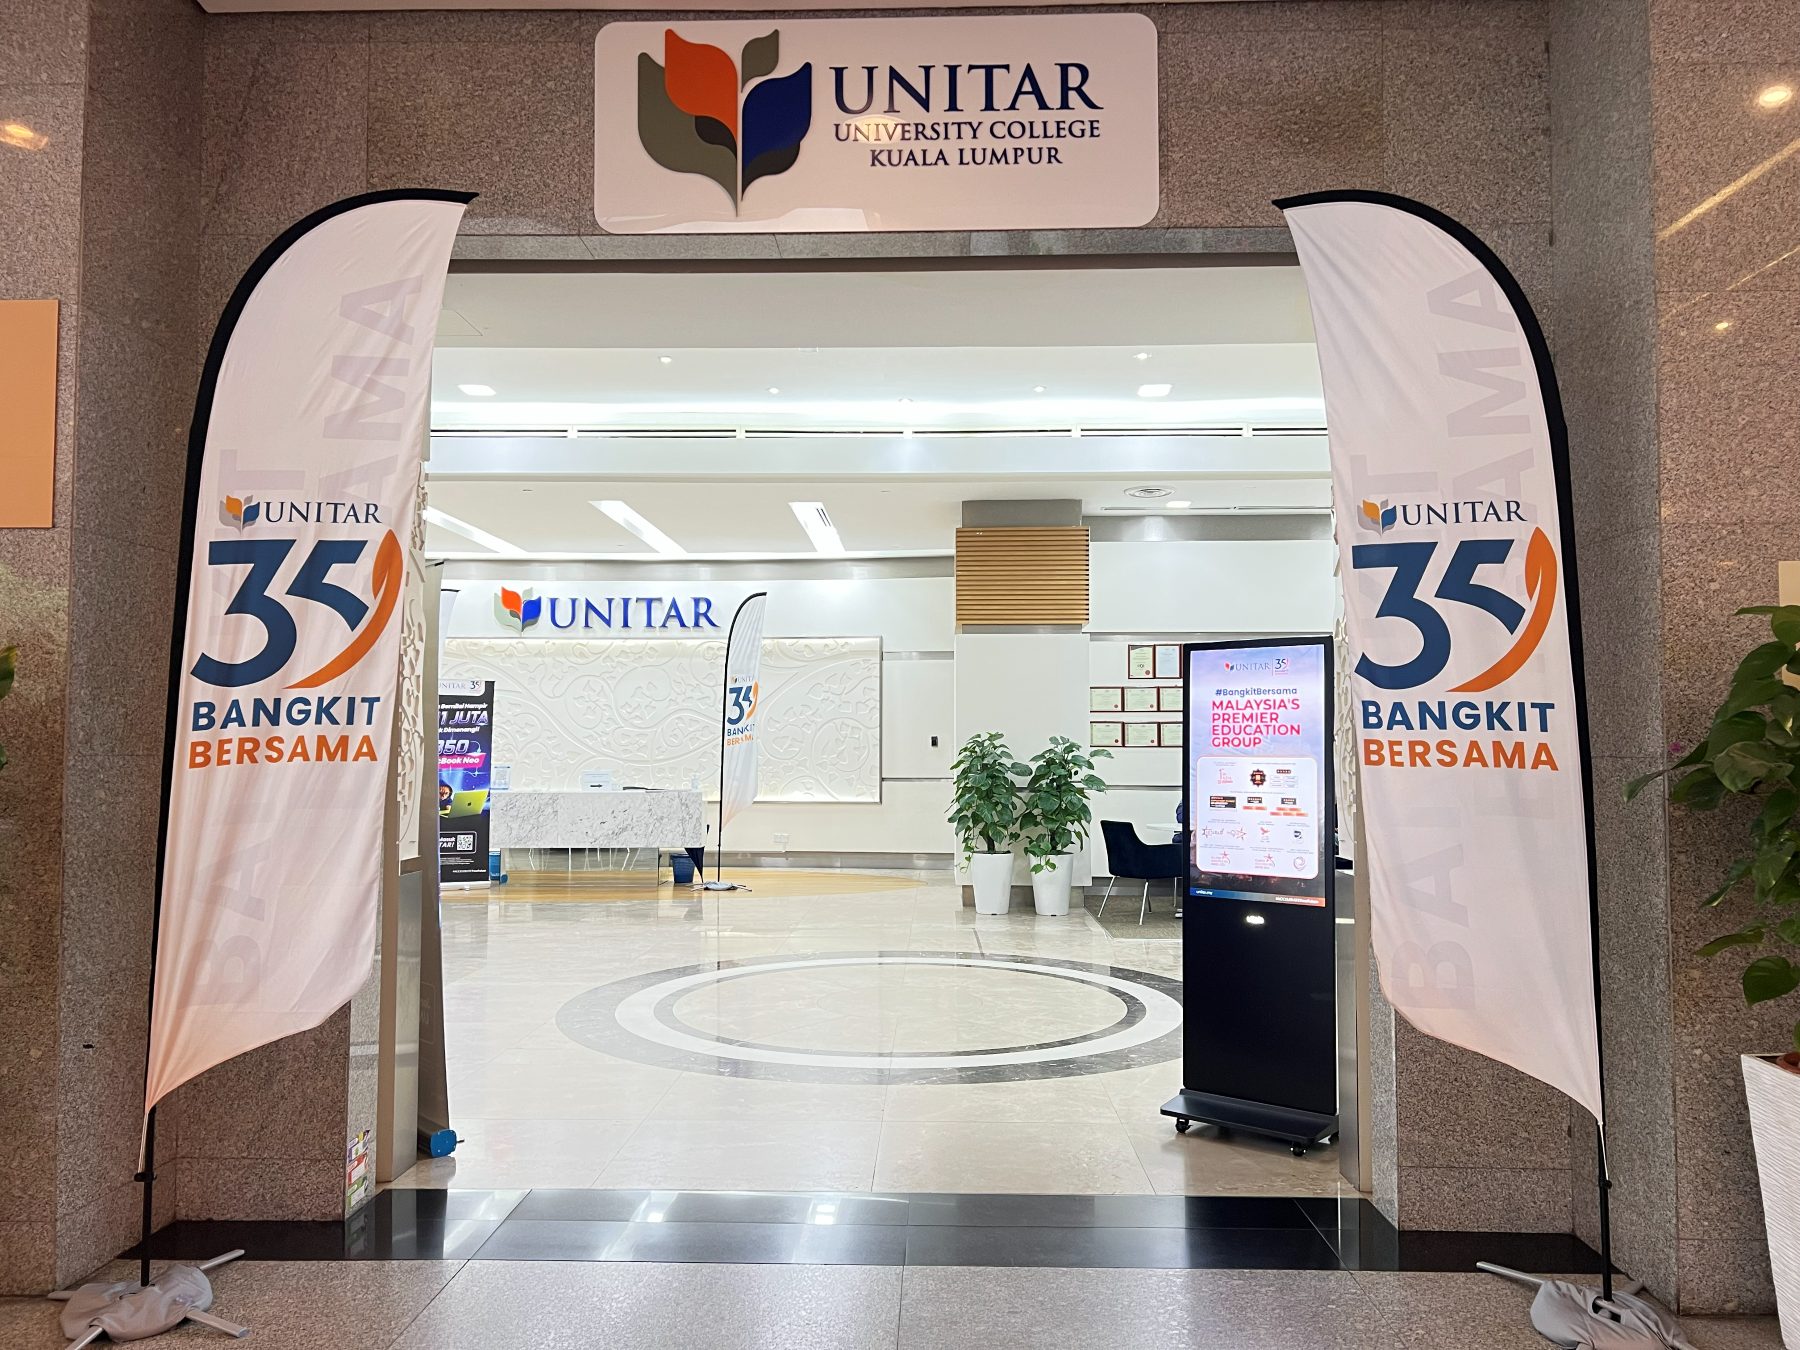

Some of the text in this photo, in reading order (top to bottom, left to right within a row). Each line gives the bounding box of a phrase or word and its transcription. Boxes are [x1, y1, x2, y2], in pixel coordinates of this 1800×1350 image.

[829, 62, 1104, 115] UNITAR
[834, 118, 1101, 142] UNIVERSITY COLLEGE
[870, 147, 1063, 167] KUALA LUMPUR
[264, 501, 382, 524] UNITAR
[1400, 500, 1528, 526] UNITAR
[190, 529, 403, 688] 35
[547, 597, 720, 629] UNITAR
[1351, 527, 1557, 692] 35
[1235, 658, 1289, 671] UNITAR 35
[1211, 698, 1301, 711] MALAYSIA'S
[1215, 688, 1298, 698] #BangkitBersama
[191, 696, 381, 732] BANGKIT
[449, 710, 489, 726] JUTA
[1211, 712, 1280, 724] PREMIER
[1361, 700, 1555, 733] BANGKIT
[1211, 724, 1301, 736] EDUCATION
[1211, 736, 1262, 748] GROUP
[188, 734, 378, 770] BERSAMA
[1363, 738, 1559, 772] BERSAMA
